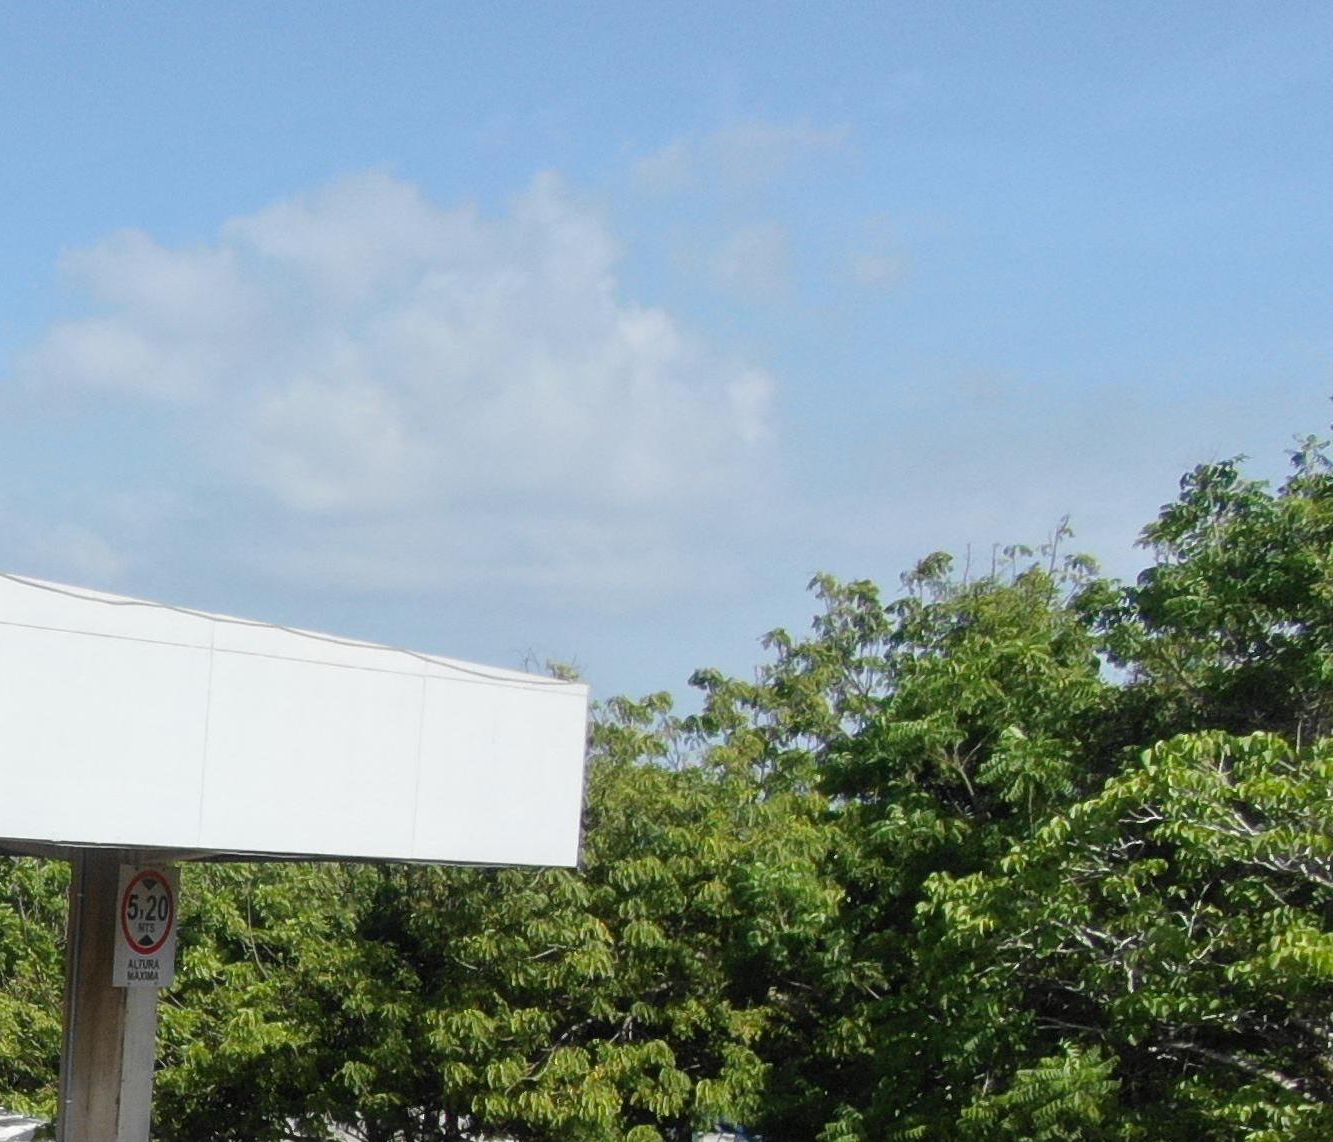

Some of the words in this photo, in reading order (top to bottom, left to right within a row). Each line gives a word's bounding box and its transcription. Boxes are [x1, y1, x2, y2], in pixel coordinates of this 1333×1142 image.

[127, 894, 169, 921] 5,20
[138, 922, 155, 933] MTS
[127, 959, 160, 970] ALTURA
